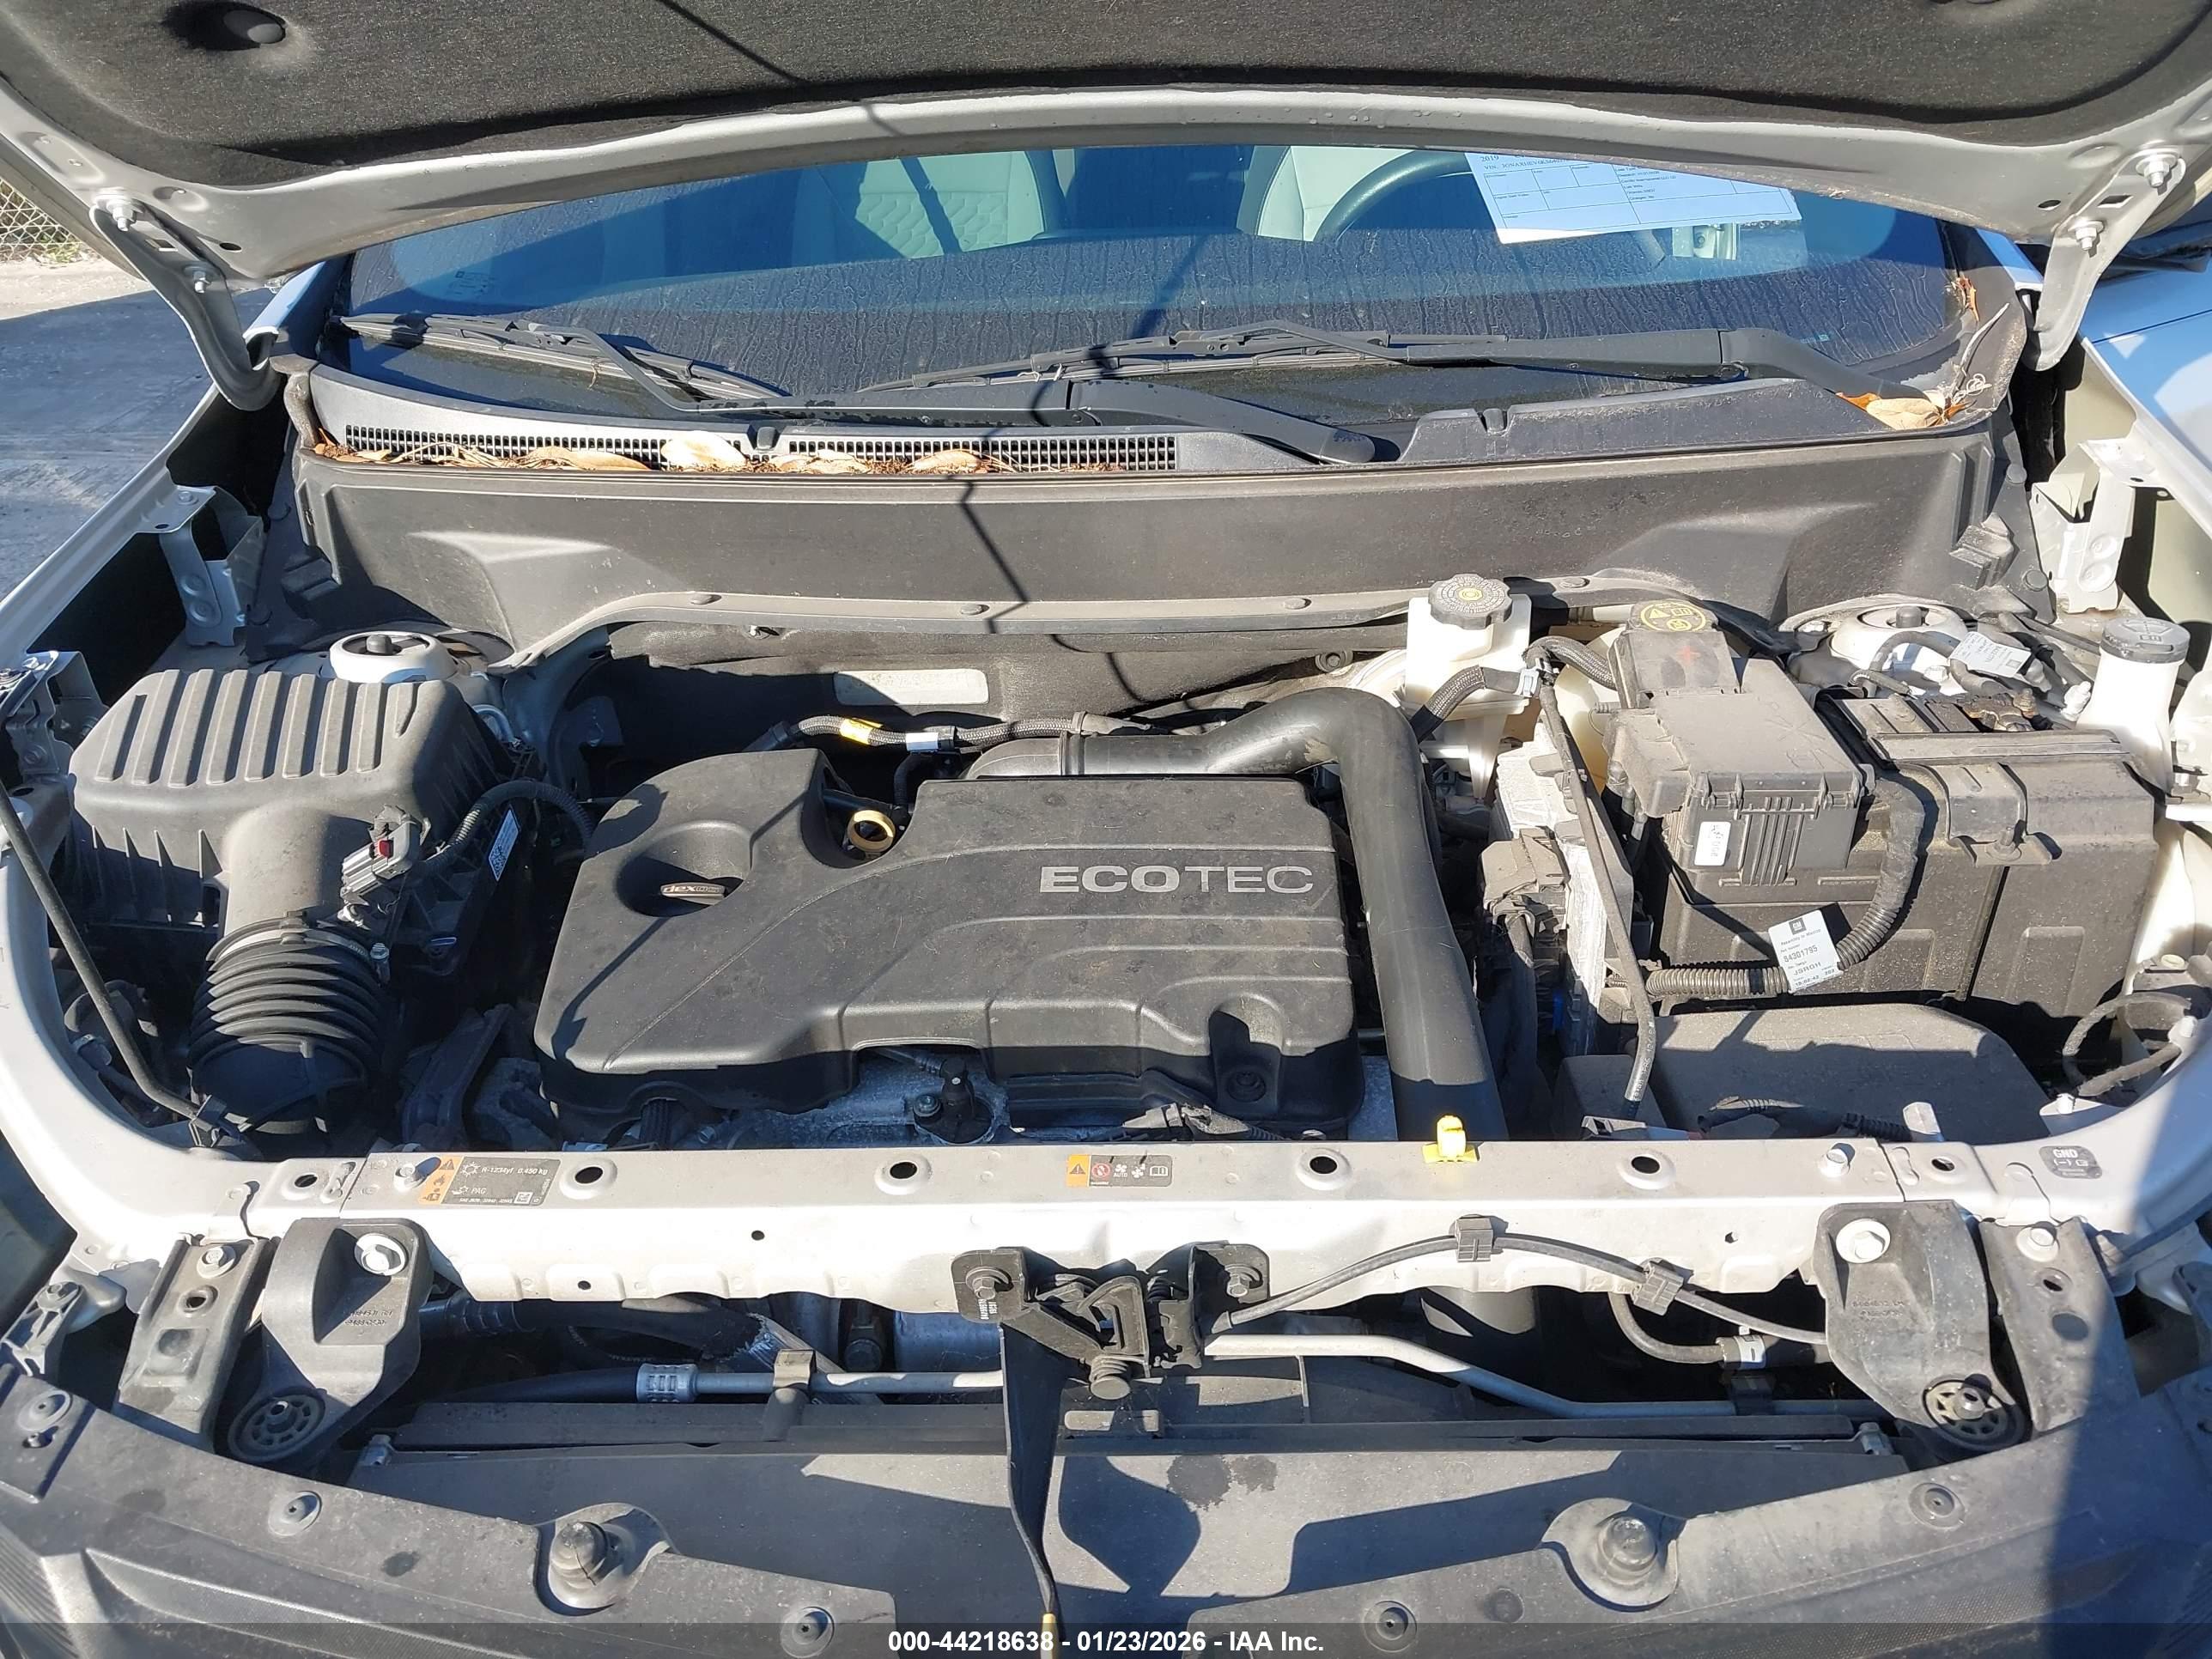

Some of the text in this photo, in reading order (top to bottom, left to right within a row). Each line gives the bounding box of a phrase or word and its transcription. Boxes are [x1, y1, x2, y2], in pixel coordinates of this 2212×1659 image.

[1040, 865, 1313, 894] ECOTEC
[2052, 1149, 2078, 1158] GND
[482, 1166, 514, 1176] R-1234yf
